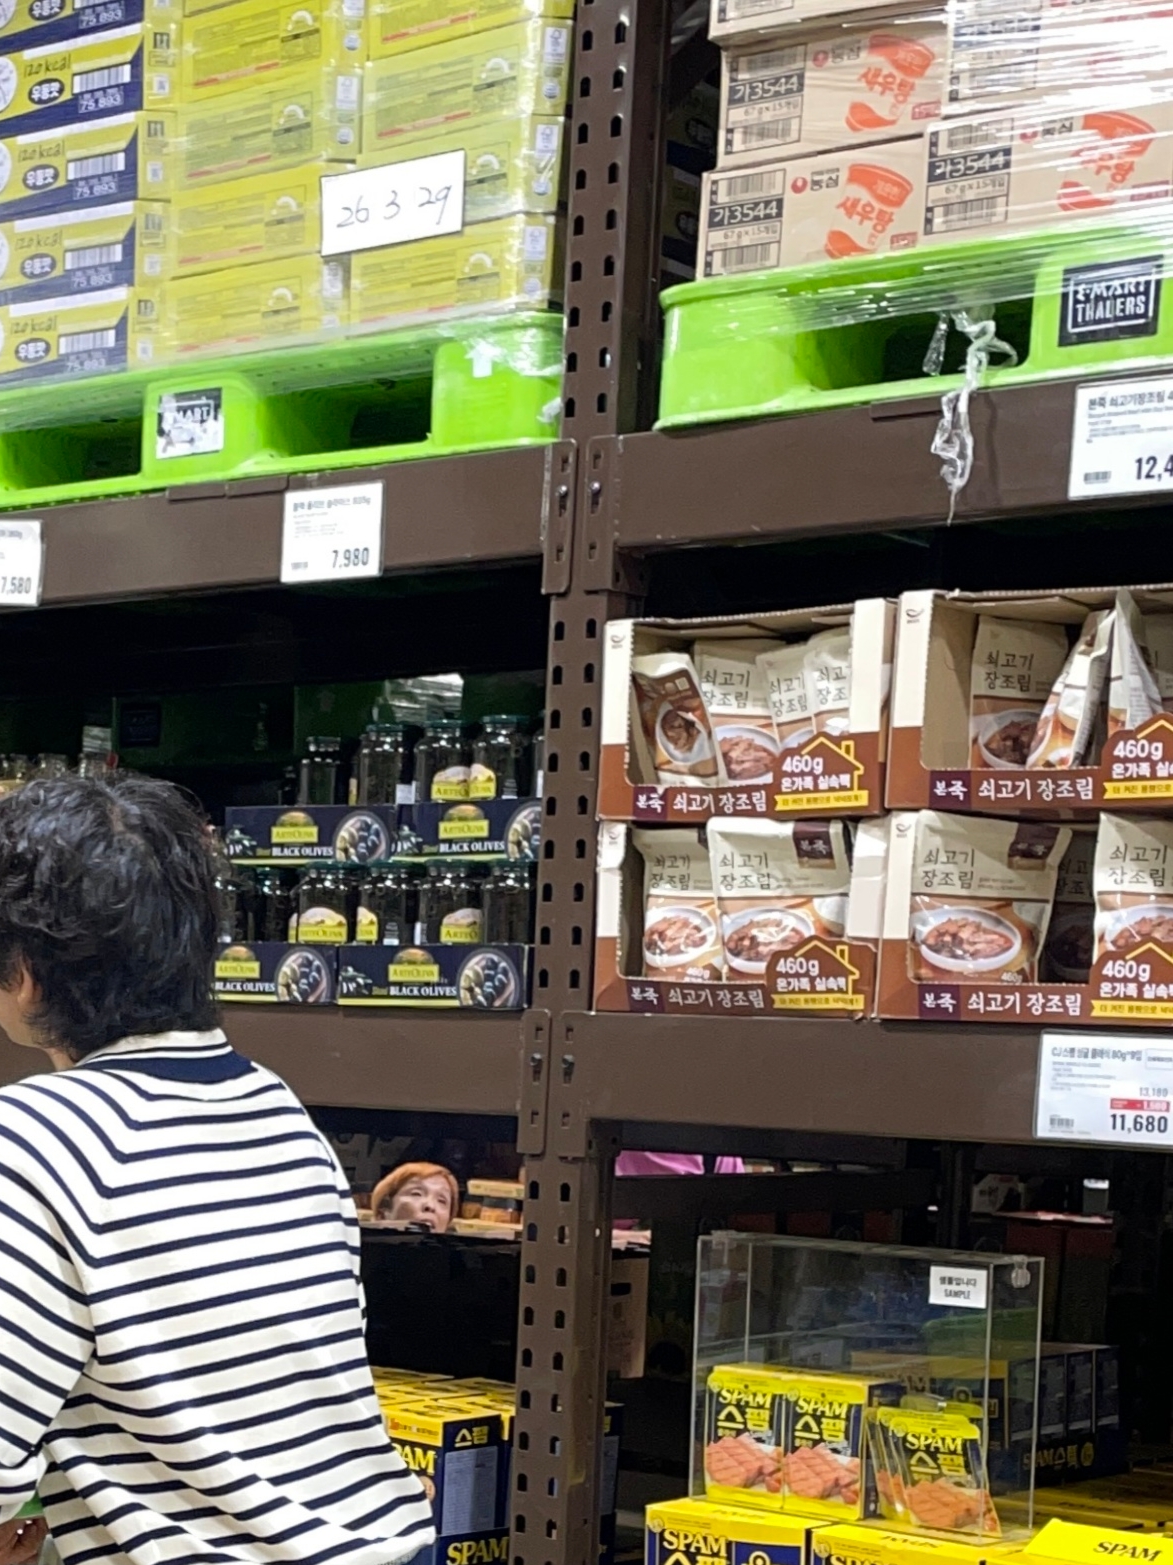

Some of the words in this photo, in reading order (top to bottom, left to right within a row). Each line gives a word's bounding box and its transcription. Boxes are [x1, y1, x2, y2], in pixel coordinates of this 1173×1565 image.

[734, 75, 799, 102] 가3544
[857, 67, 916, 104] 새우탕
[935, 151, 1005, 179] 가3544
[810, 172, 839, 191] 농심
[336, 196, 370, 229] 26
[383, 190, 401, 220] 3
[418, 184, 453, 226] 29
[713, 201, 778, 226] 가3544
[835, 196, 894, 234] 새우탕
[331, 546, 370, 569] 7,980
[0, 577, 31, 595] 7,580
[985, 652, 1035, 670] 쇠고기
[770, 676, 806, 695] 쇠고기
[984, 673, 1032, 692] 장조림
[772, 694, 808, 718] 장조림
[1113, 740, 1163, 760] 460g
[782, 754, 823, 774] 460g
[1112, 763, 1151, 779] 온가족
[781, 775, 814, 791] 온가족
[818, 773, 851, 790] 실속팩
[933, 779, 968, 800] 본죽
[978, 779, 1031, 801] 쇠고기
[1037, 777, 1093, 801] 장조림
[636, 793, 664, 813] 본죽
[673, 792, 715, 814] 쇠고기
[719, 790, 767, 814] 장조림
[272, 846, 300, 857] BLACK
[302, 845, 333, 856] OLIVES
[440, 842, 469, 853] BLACK
[470, 841, 505, 852] OLIVES
[1109, 844, 1168, 864] 쇠고기
[719, 852, 769, 869] 쇠고기
[720, 873, 771, 891] 장조림
[1108, 867, 1165, 887] 장조림
[776, 957, 820, 977] 460g
[1102, 960, 1151, 980] 460g
[215, 980, 242, 992] BLACK
[243, 981, 275, 992] OLIVES
[390, 985, 419, 996] BLACK
[421, 985, 456, 996] OLIVES
[776, 976, 810, 991] 온가족
[1100, 982, 1138, 998] 온가족
[631, 986, 658, 1005] 본죽
[668, 988, 714, 1007] 쇠고기
[717, 988, 765, 1009] 장조림
[922, 993, 957, 1012] 본죽
[967, 991, 1021, 1014] 쇠고기
[1027, 992, 1082, 1016] 장조림
[1110, 1113, 1169, 1134] 11,680
[944, 1289, 971, 1300] SAMPLE
[719, 1387, 772, 1408] SPAM
[795, 1395, 848, 1418] SPAM
[717, 1406, 770, 1431] 스팸
[795, 1414, 846, 1442] 스팸
[454, 1426, 489, 1447] 스팸
[905, 1432, 963, 1454] SPAM
[393, 1443, 436, 1475] PAM
[910, 1451, 966, 1476] 스팸
[663, 1528, 728, 1557] SPAM
[1093, 1541, 1162, 1562] SPAM
